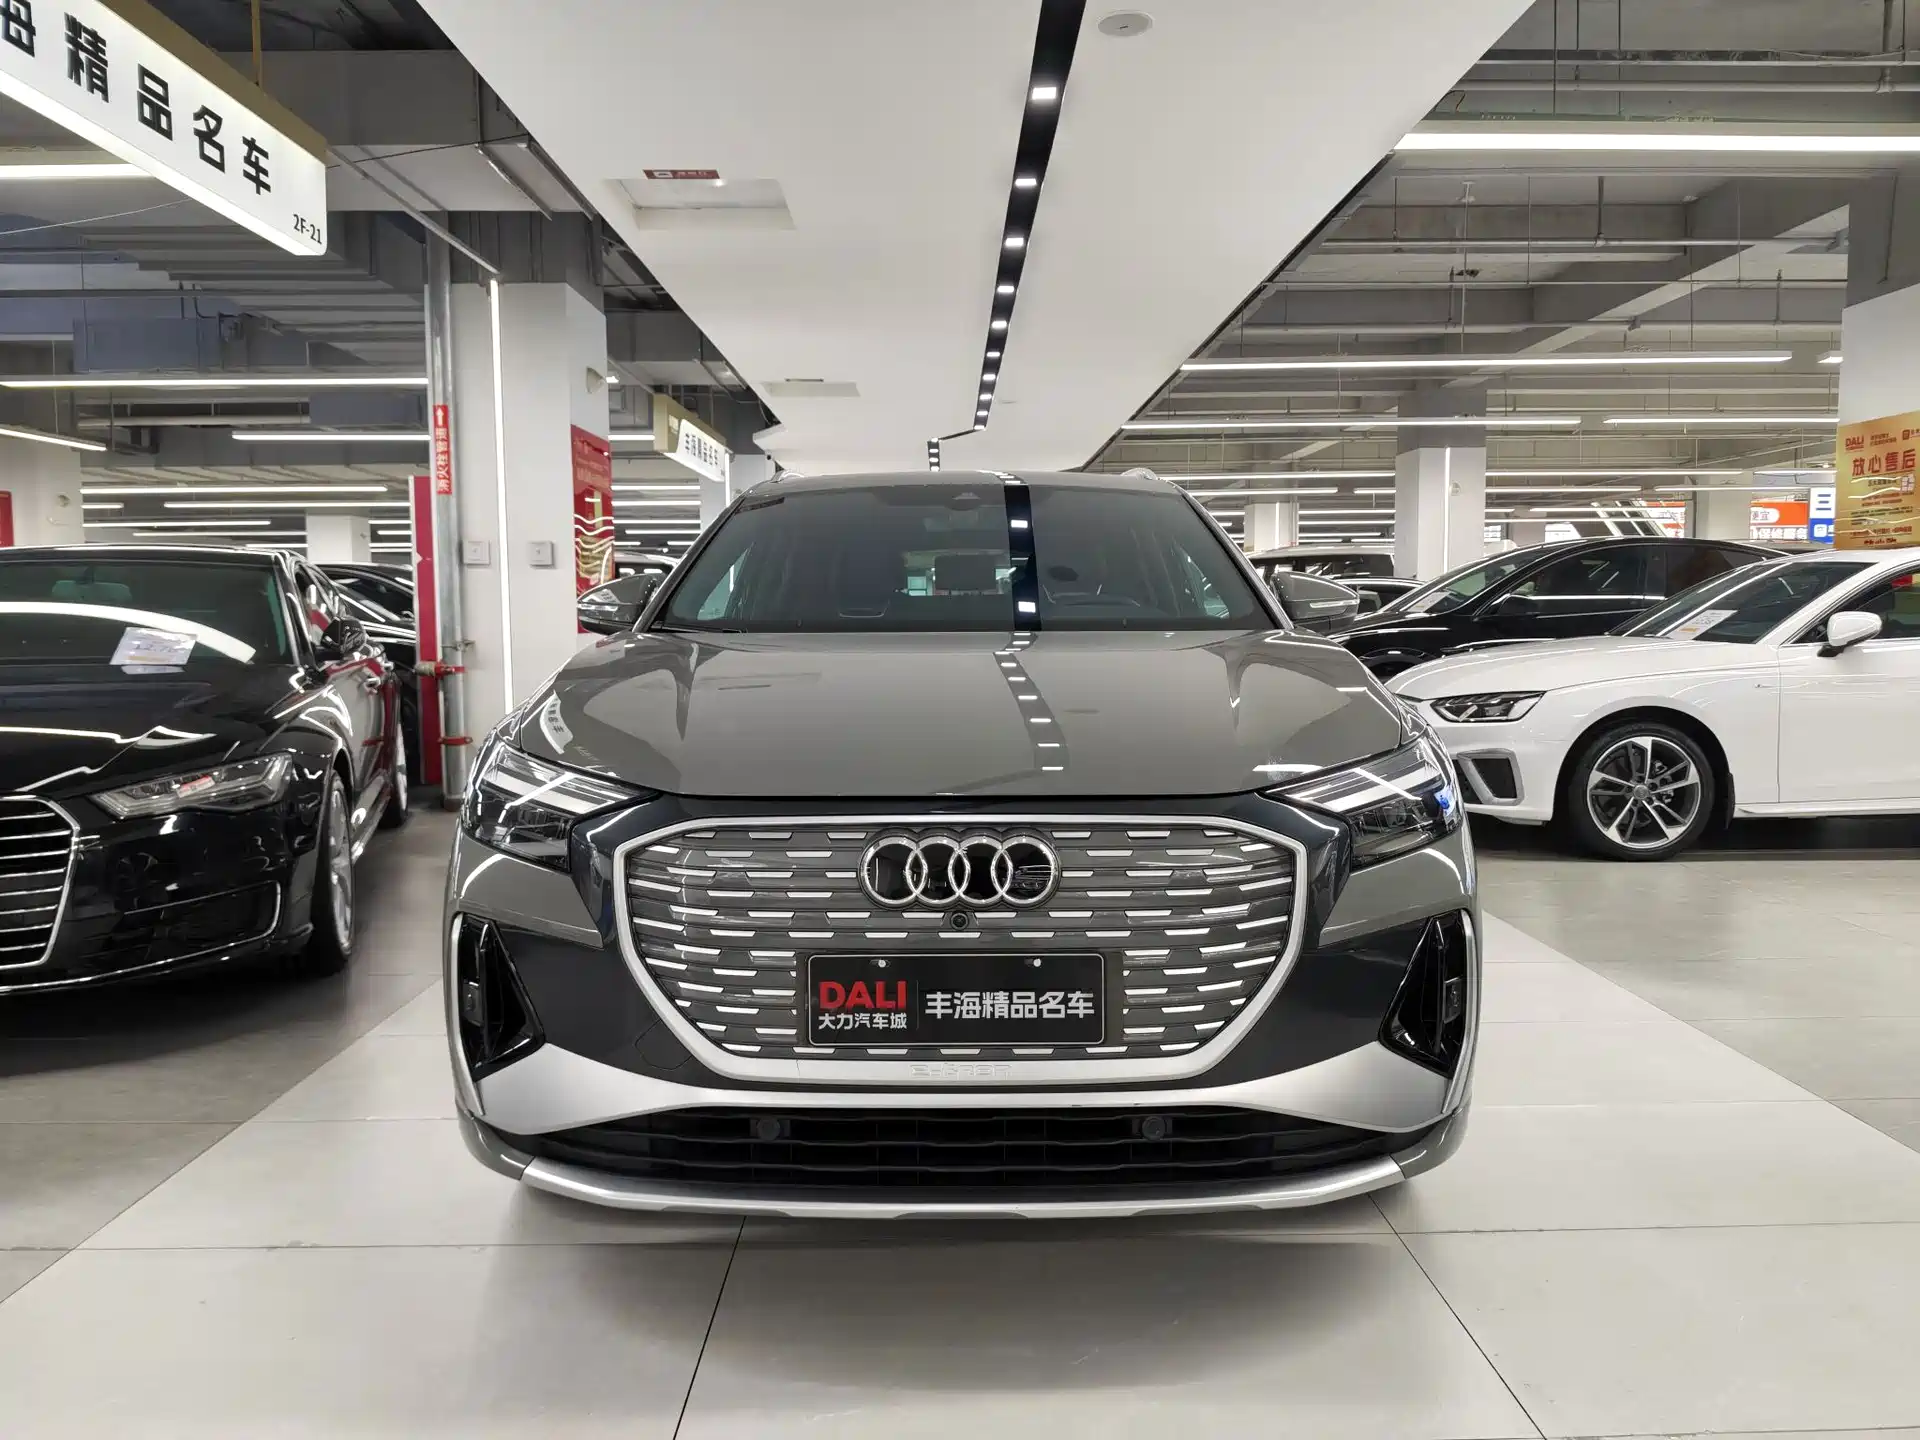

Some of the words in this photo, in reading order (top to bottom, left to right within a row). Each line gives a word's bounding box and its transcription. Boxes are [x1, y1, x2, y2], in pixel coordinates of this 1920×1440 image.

[293, 213, 322, 245] 2F-21
[1852, 448, 1916, 477] 放心售后
[819, 980, 907, 1010] DALI
[925, 990, 1095, 1019] 丰海精品名车
[818, 1012, 907, 1030] 大力汽车城
